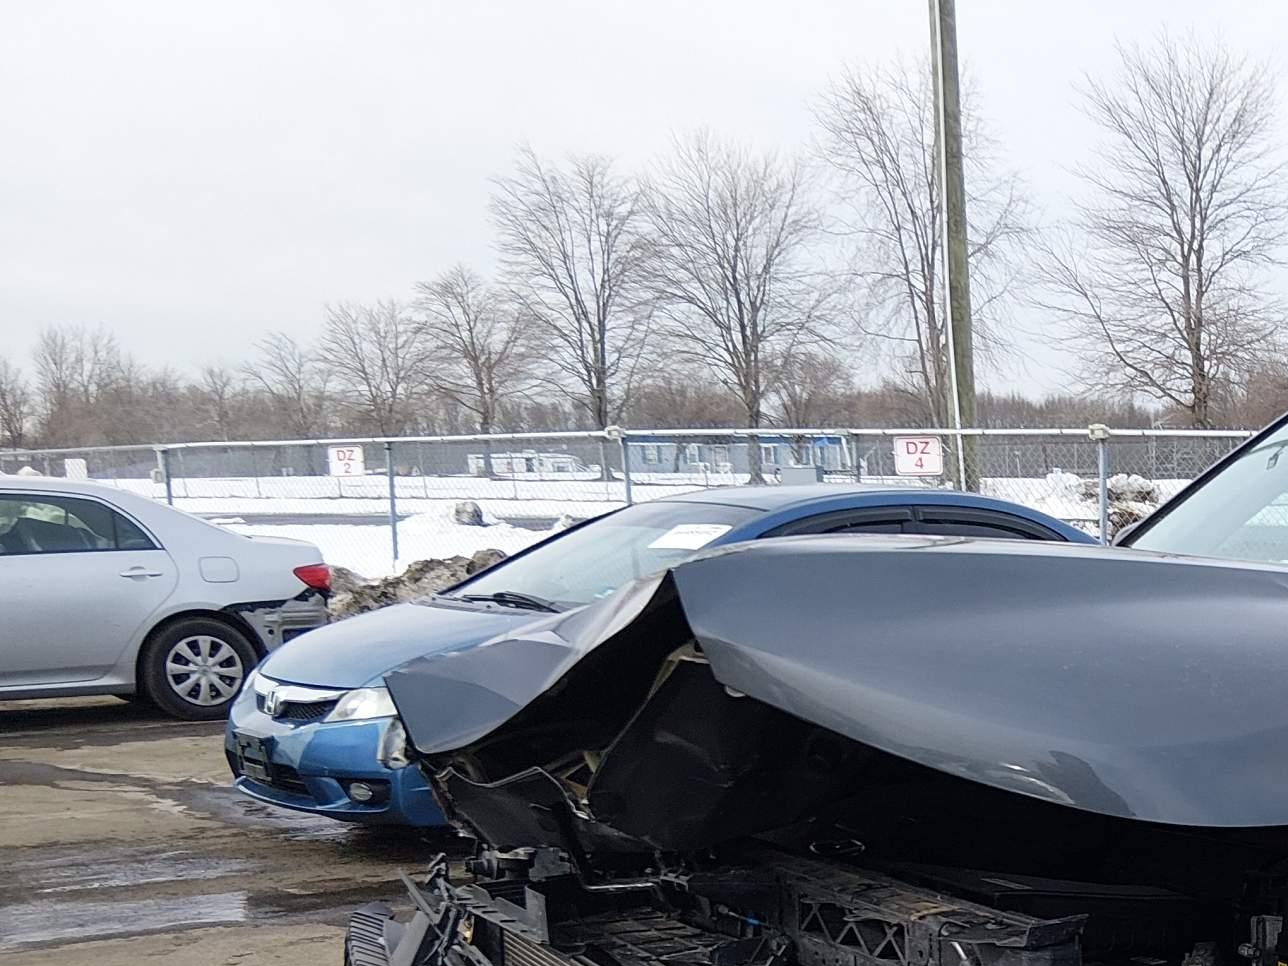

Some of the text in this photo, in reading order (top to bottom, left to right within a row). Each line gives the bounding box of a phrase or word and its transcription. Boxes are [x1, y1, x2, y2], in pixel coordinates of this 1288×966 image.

[905, 441, 930, 455] DZ
[336, 449, 355, 461] DZ
[343, 462, 352, 474] 2
[914, 456, 925, 470] 4
